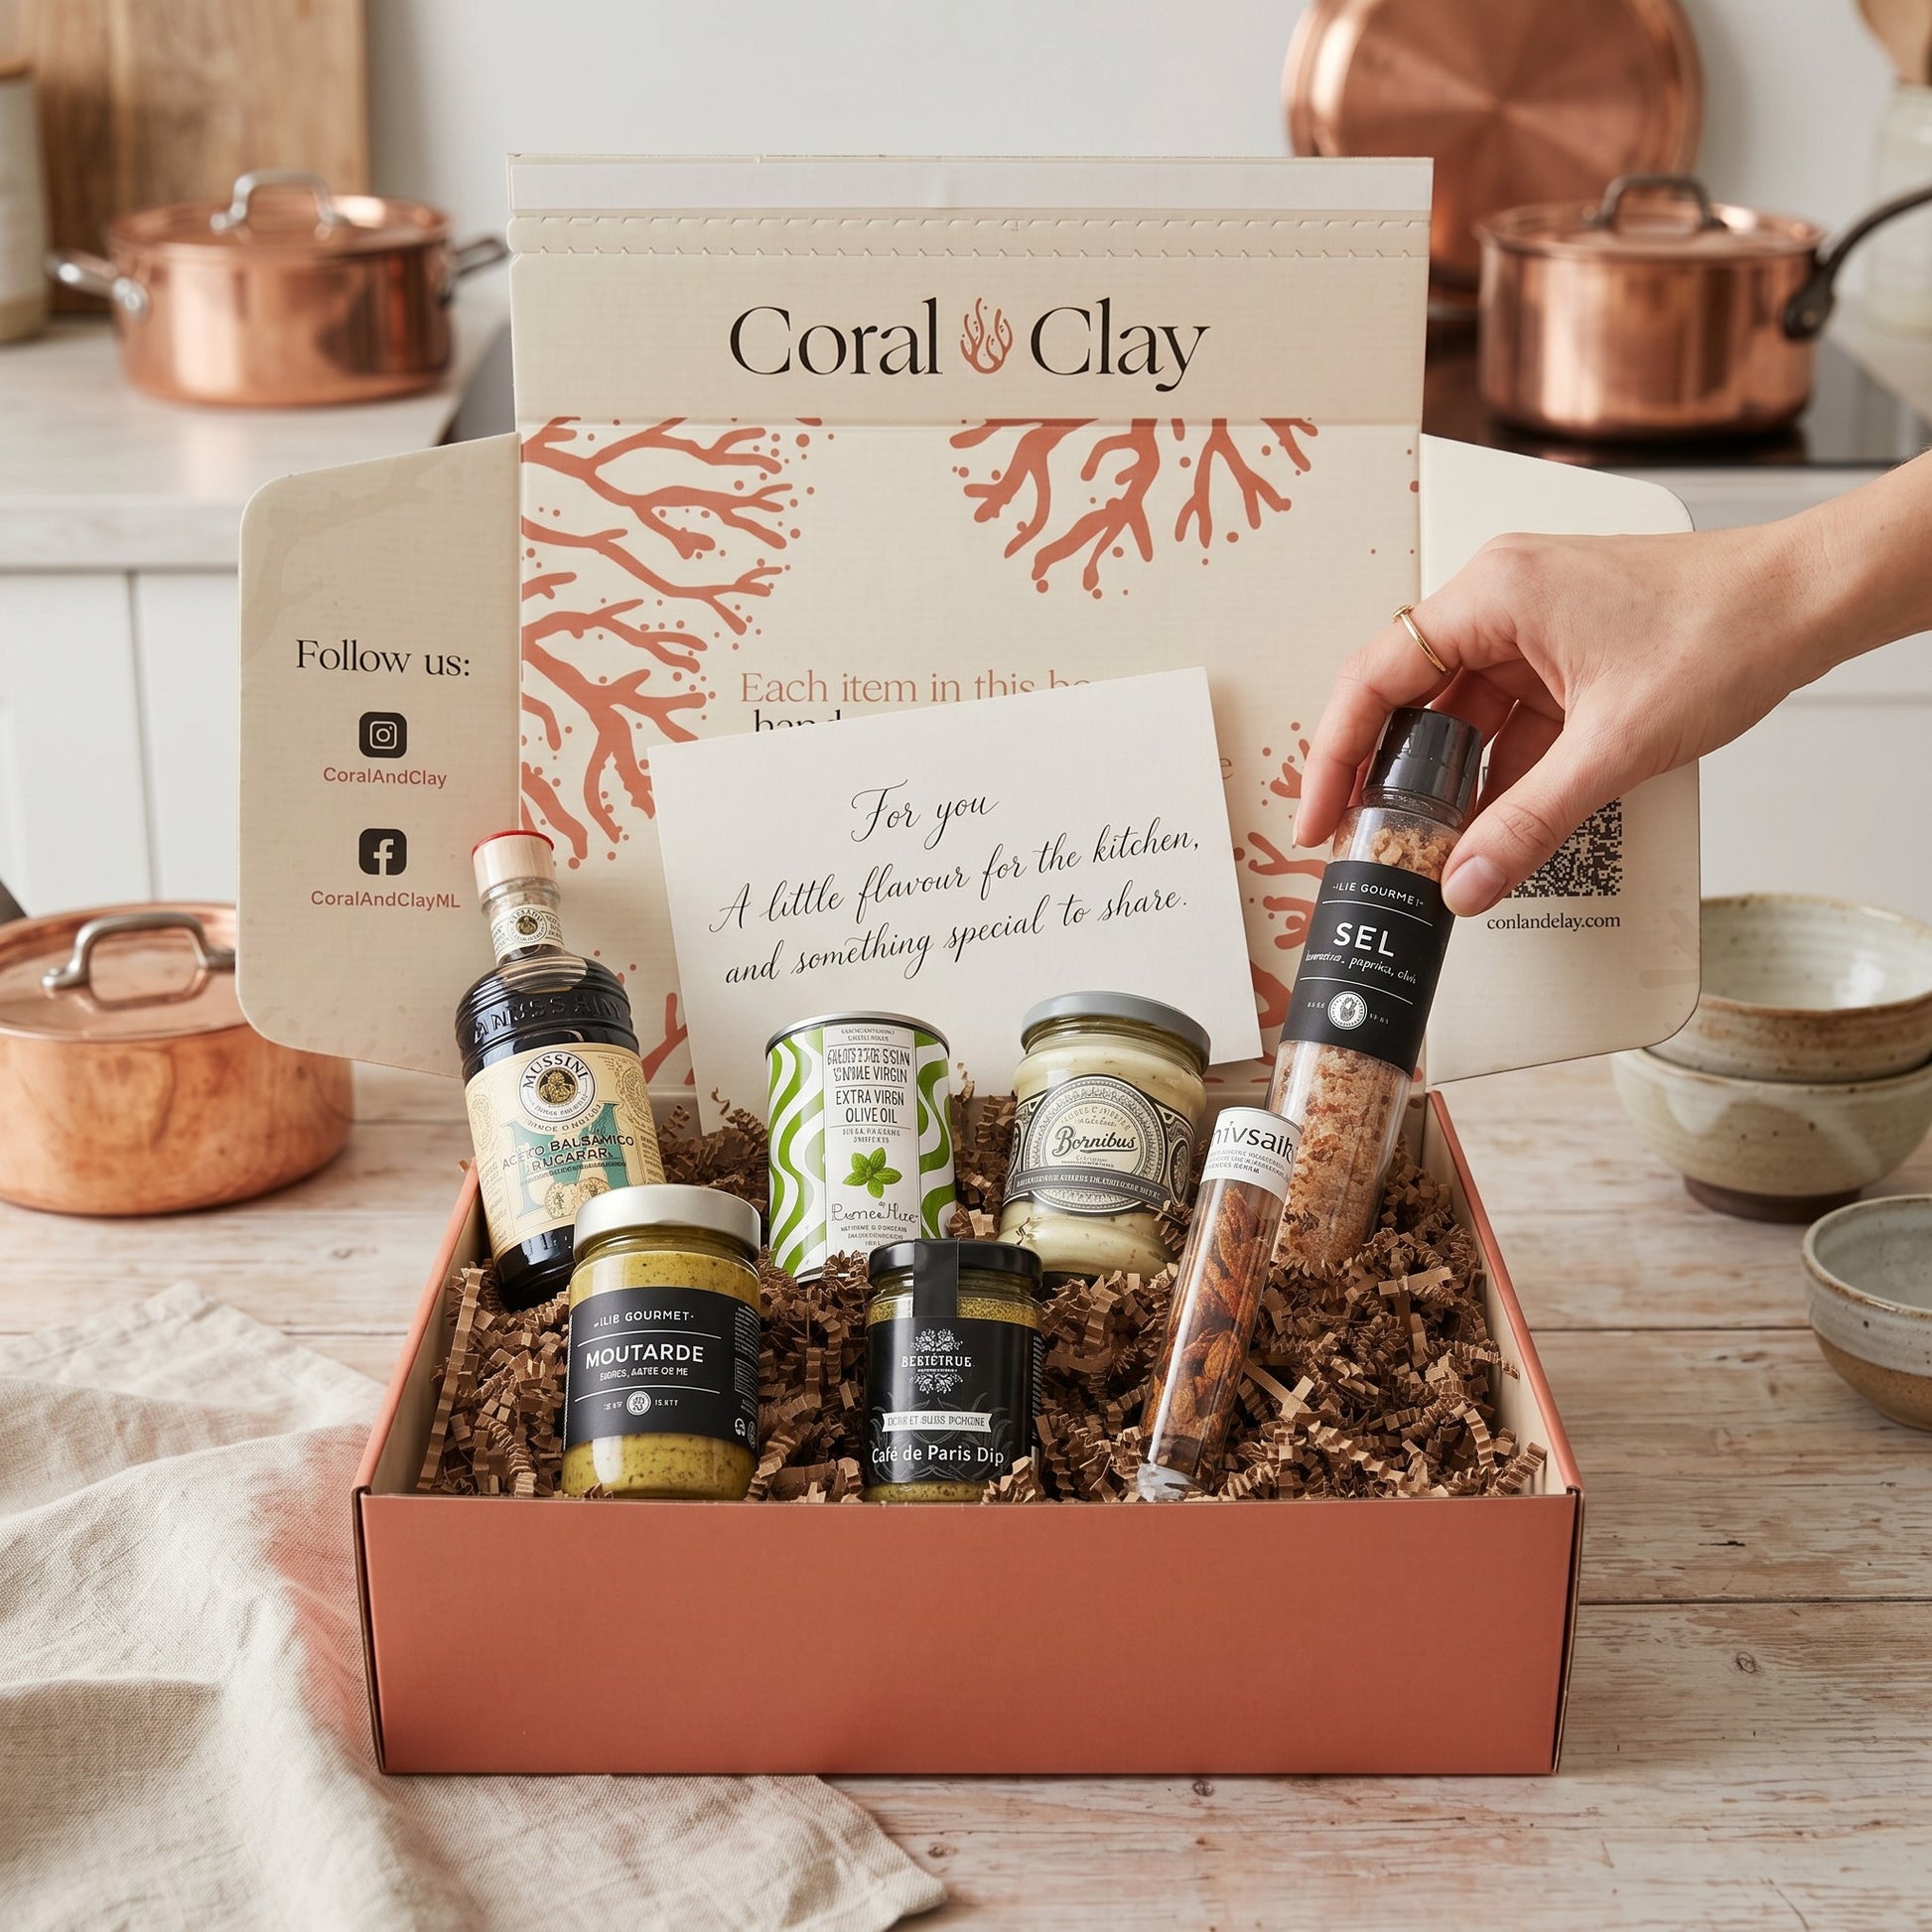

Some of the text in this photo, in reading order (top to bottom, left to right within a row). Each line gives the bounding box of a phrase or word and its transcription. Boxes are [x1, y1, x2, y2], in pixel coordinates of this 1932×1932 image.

[730, 297, 1211, 392] Coral Clay
[296, 638, 471, 677] Follow us:
[741, 669, 828, 702] Each
[842, 673, 917, 702] item
[930, 672, 961, 702] in
[974, 669, 1035, 700] this
[323, 766, 447, 789] CoralAndClay
[851, 779, 1000, 850] For you
[708, 816, 1199, 932] A little flavour for the kitchen,
[311, 890, 462, 911] CoralAndClayML
[726, 880, 1188, 983] and something special to share.
[1486, 912, 1621, 932] conlandelay.com
[1332, 922, 1394, 958] SEL
[522, 1053, 589, 1089] MUSSINI
[873, 1065, 907, 1083] VIRGIN
[836, 1089, 872, 1105] EXTRA
[846, 1107, 897, 1124] OLIVE OIL
[550, 1134, 634, 1152] BALSAMICO
[1051, 1125, 1139, 1157] Bornibus
[624, 1311, 690, 1322] GOURMET
[586, 1343, 704, 1369] MOUTARDE
[872, 1444, 1004, 1466] Café de Paris Dip
